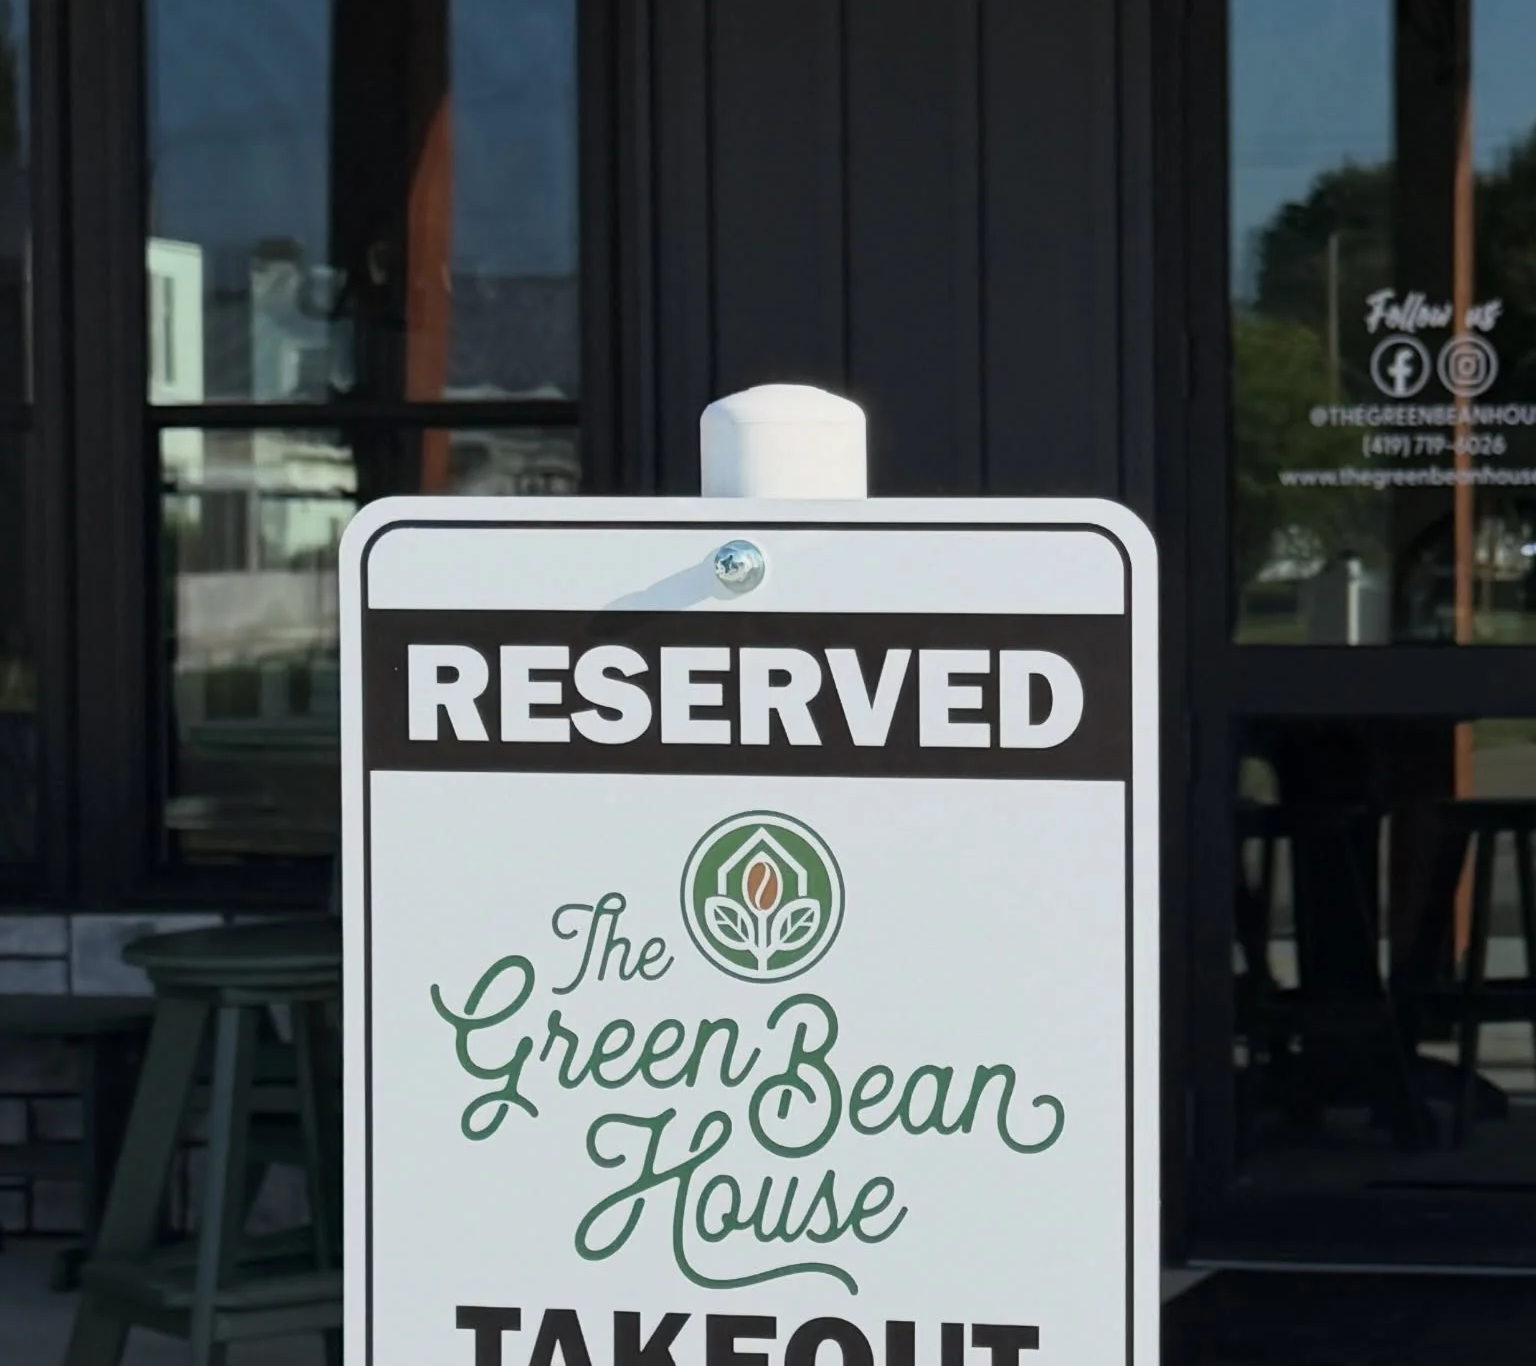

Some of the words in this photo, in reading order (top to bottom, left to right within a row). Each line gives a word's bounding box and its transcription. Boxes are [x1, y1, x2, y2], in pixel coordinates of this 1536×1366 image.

[1363, 288, 1453, 333] Follow
[1464, 298, 1503, 332] us
[407, 643, 1085, 749] RESERVED
[551, 891, 674, 995] The
[430, 954, 759, 1141] Green
[749, 992, 1066, 1159] Bean
[574, 1108, 908, 1294] House
